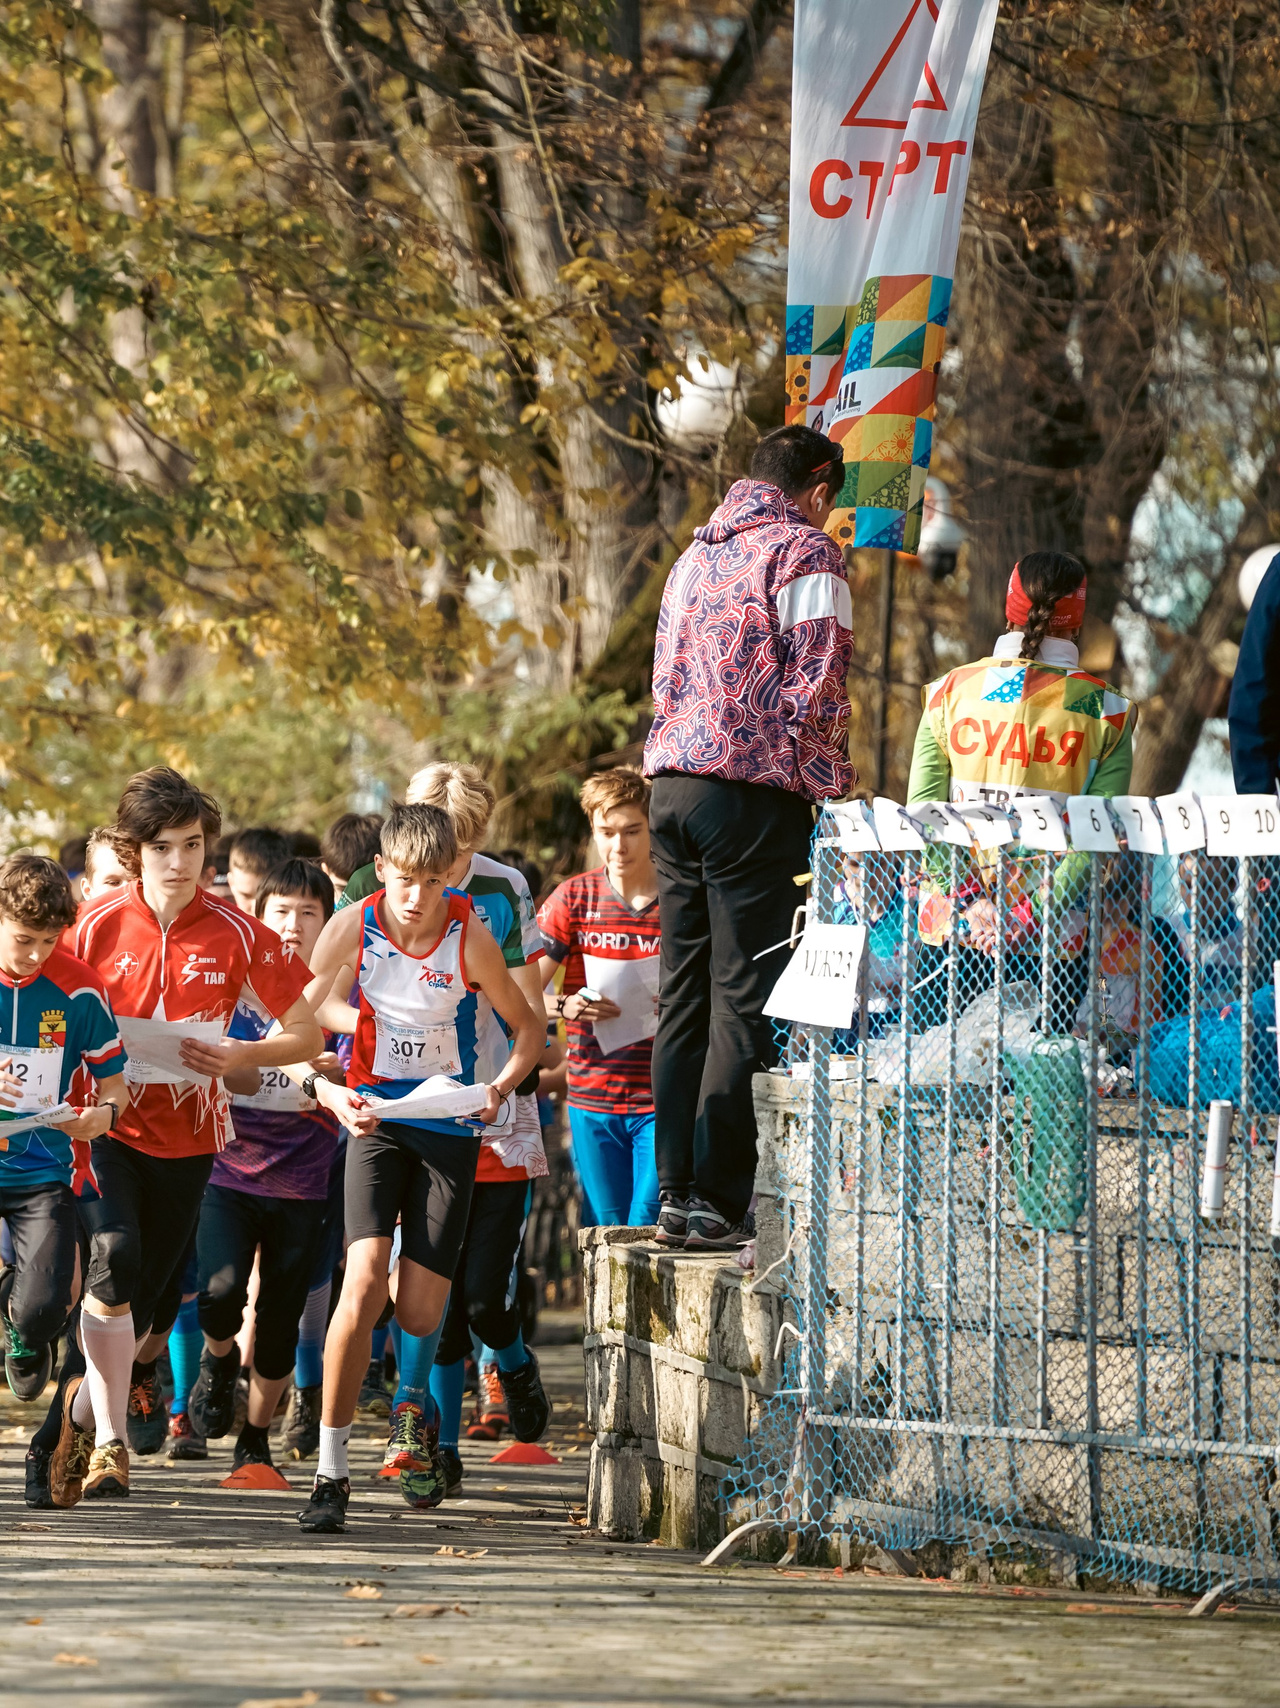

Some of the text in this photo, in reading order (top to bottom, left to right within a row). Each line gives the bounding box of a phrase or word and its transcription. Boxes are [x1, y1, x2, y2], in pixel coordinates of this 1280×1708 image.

[809, 140, 967, 219] СТРТ
[950, 717, 1085, 768] СУДЬЯ
[930, 809, 949, 826] 3
[1032, 809, 1048, 831] 5
[1090, 809, 1101, 832] 6
[1132, 808, 1143, 832] 7
[1178, 806, 1190, 830] 8
[1220, 809, 1275, 834] 9 10
[577, 931, 629, 951] NORD
[389, 1052, 410, 1065] МЖ14
[391, 1038, 441, 1058] 307 1
[37, 1074, 43, 1085] 1
